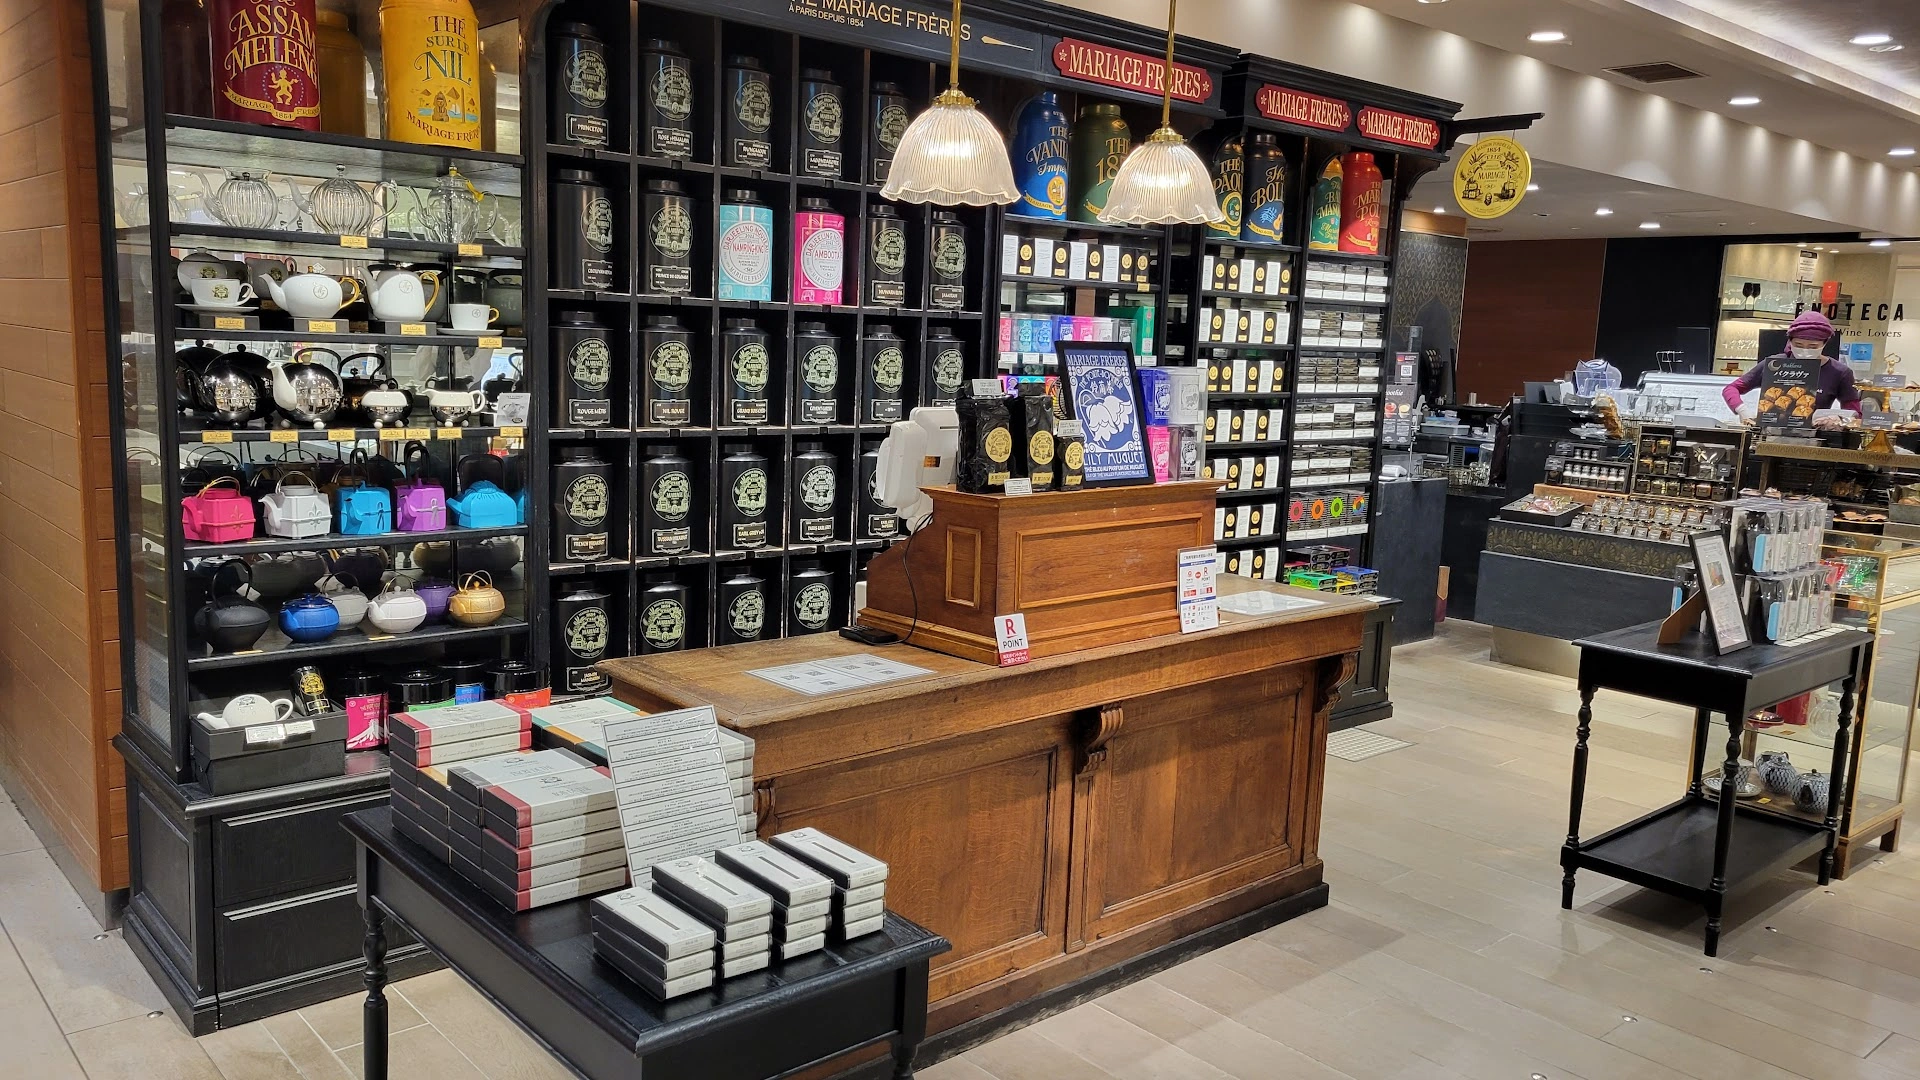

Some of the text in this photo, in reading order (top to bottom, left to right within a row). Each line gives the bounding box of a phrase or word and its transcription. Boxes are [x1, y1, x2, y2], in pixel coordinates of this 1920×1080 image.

[788, 4, 865, 28] À PARIS DEPUIS 1854
[822, 0, 902, 26] MARIAGE
[229, 4, 316, 61] ASSAM
[428, 15, 466, 39] THÉ
[426, 35, 470, 55] SUR LE
[224, 35, 317, 88] MELENG
[414, 49, 472, 86] NIL
[1068, 44, 1143, 86] MARIAGE
[230, 93, 272, 111] MARIAGE
[1266, 90, 1344, 128] MARIAGE FRÈRES
[406, 110, 455, 140] MARIAGE
[578, 123, 603, 134] PRINCETON
[1365, 110, 1433, 145] MARIAGE FRÈRES
[1477, 171, 1506, 180] MARIAGE
[724, 226, 753, 250] DARJEELING
[1868, 329, 1902, 338] Lovers
[1066, 352, 1127, 366] MARIAGE FRÈRES
[1084, 452, 1143, 466] LILY MUGUET
[1005, 618, 1016, 635] R
[1002, 638, 1023, 649] POINT
